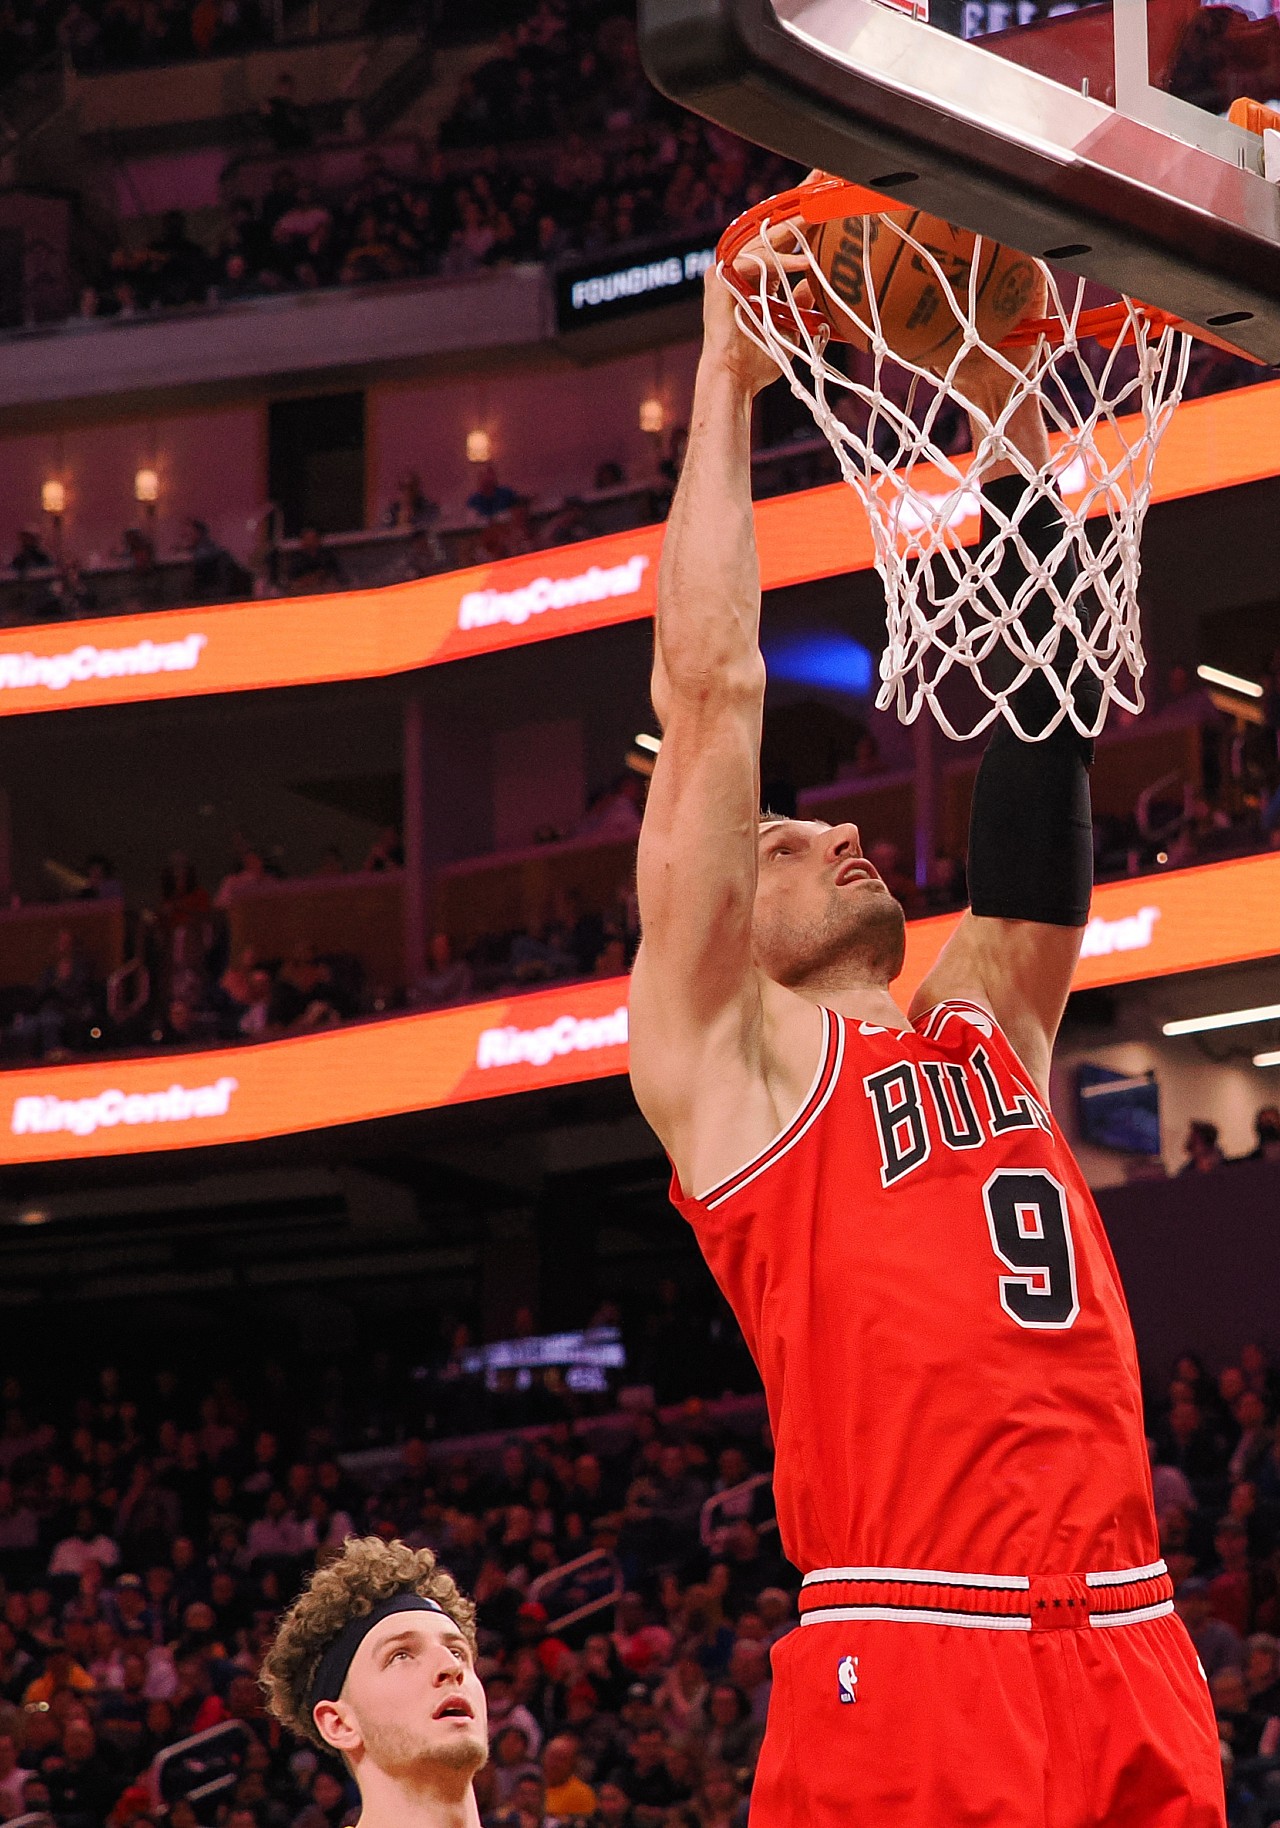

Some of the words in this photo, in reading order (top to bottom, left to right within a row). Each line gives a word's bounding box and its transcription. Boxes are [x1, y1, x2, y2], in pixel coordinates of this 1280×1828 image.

[458, 555, 650, 631] RingCentral
[477, 1006, 628, 1069] RingCent
[11, 1076, 239, 1136] RingCentral
[864, 1043, 1056, 1189] BUL
[982, 1167, 1080, 1330] 9
